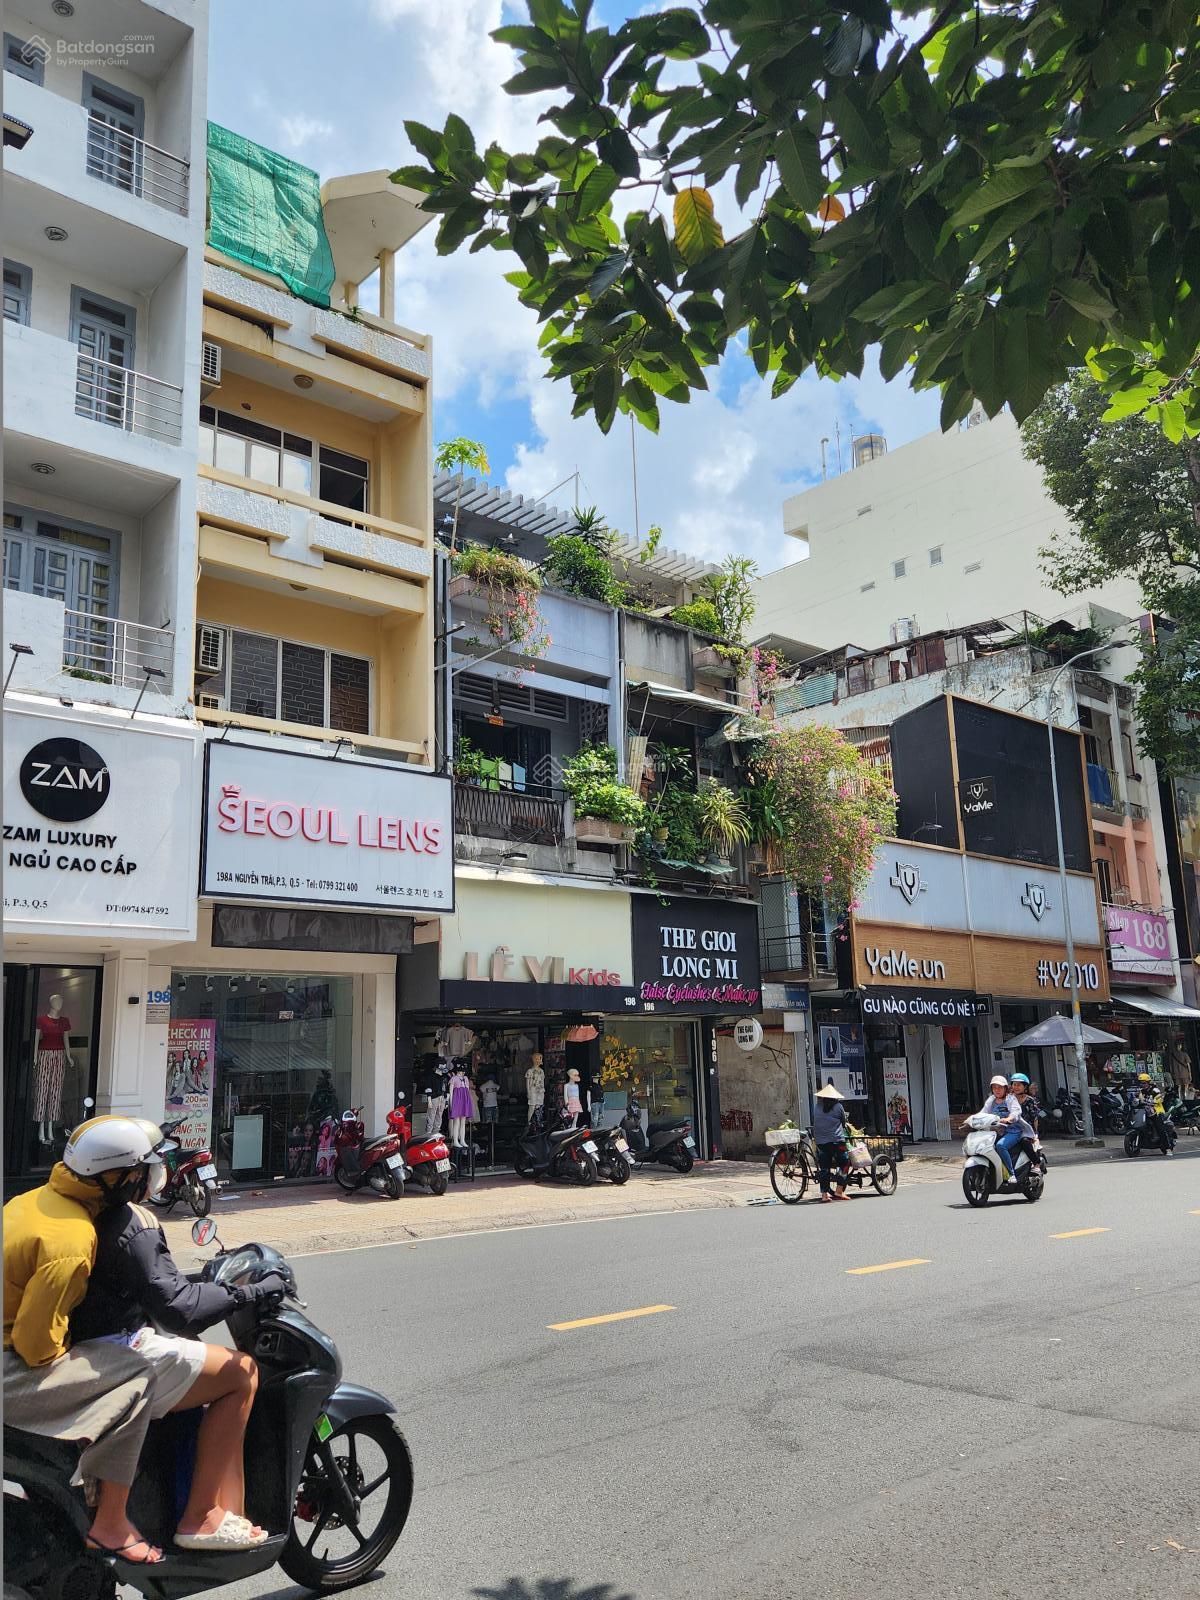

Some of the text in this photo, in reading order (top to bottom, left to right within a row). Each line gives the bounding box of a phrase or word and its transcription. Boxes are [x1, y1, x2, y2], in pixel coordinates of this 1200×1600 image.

[30, 762, 103, 792] ZAM
[963, 799, 993, 813] YaMe
[2, 825, 117, 849] ZAM LUXURY
[218, 797, 445, 855] SEOUL LENS
[9, 849, 137, 875] NGỦ CAO CẤP
[216, 871, 233, 882] 198A
[306, 879, 318, 889] Tel:
[319, 880, 334, 890] 0799
[335, 881, 346, 891] 321
[346, 883, 358, 892] 400
[660, 926, 737, 952] THE GIOI
[1132, 918, 1167, 951] 188
[568, 967, 621, 986] Kids
[661, 955, 739, 980] LONG MI
[624, 997, 636, 1006] 198
[641, 982, 667, 1001] False
[667, 983, 712, 1005] Eyelashes
[643, 1002, 655, 1011] 196
[863, 998, 880, 1013] GU
[882, 995, 907, 1014] NÀO
[909, 997, 939, 1015] CŨNG
[940, 999, 955, 1016] CÓ
[957, 999, 971, 1016] NÈ
[200, 1028, 211, 1039] IN
[187, 1040, 210, 1051] FREE
